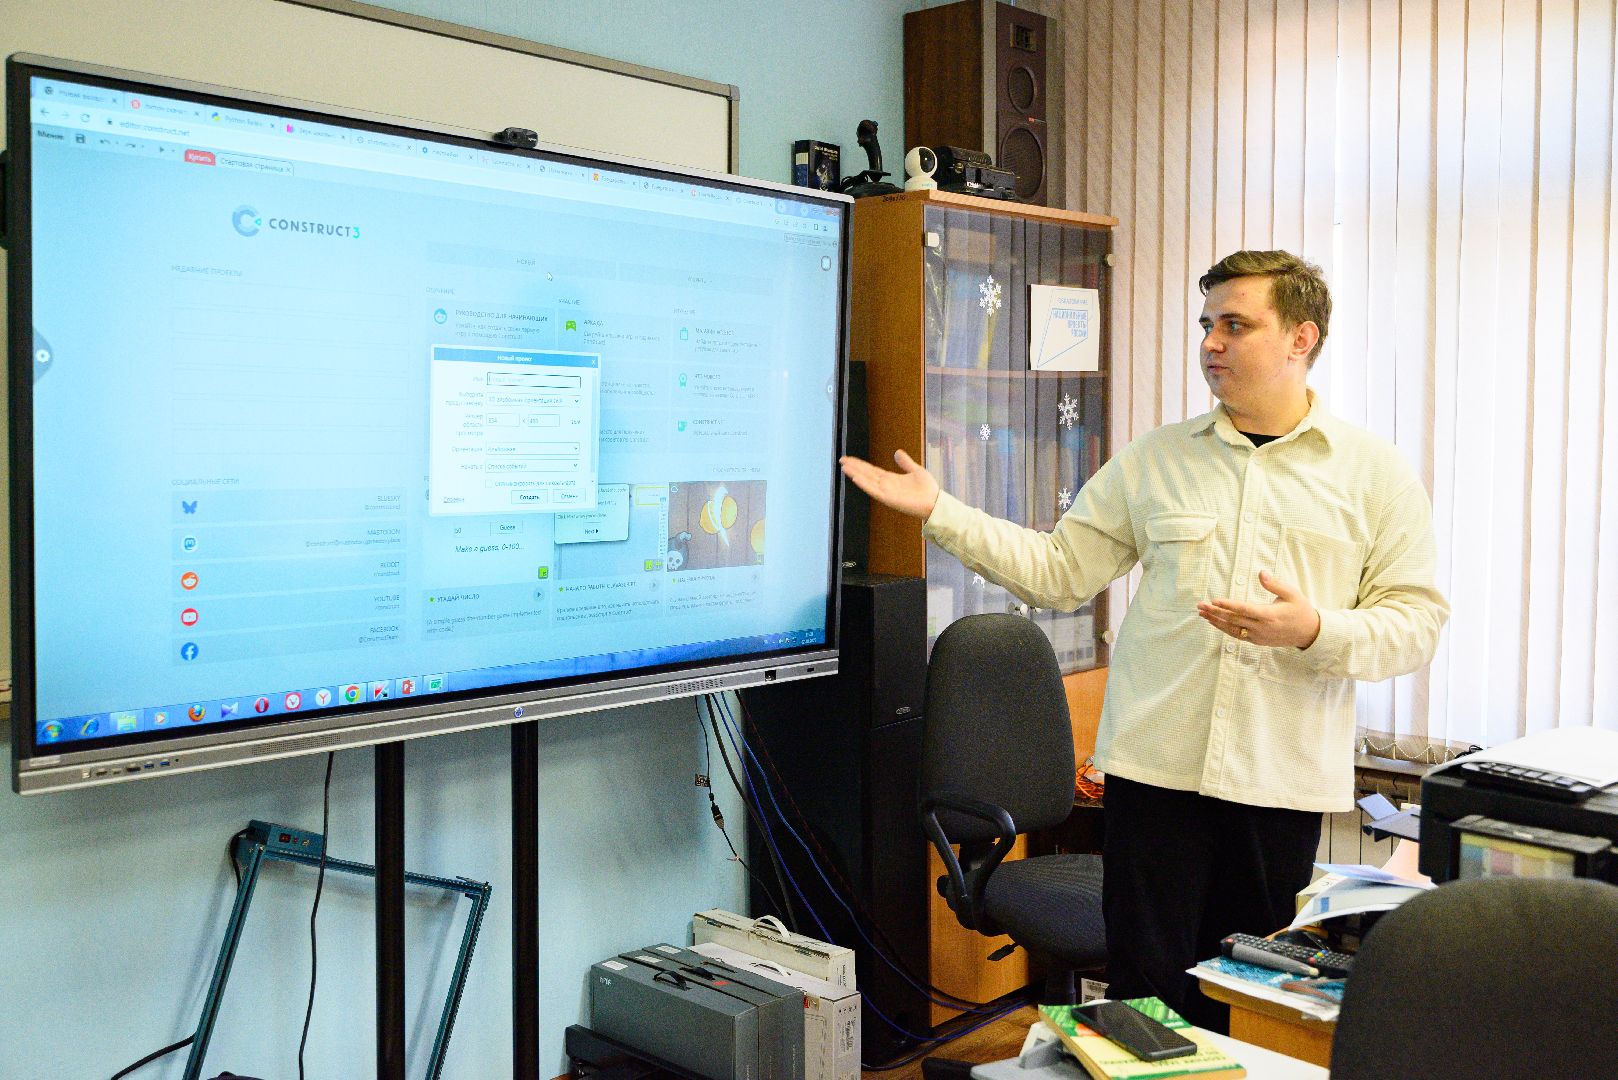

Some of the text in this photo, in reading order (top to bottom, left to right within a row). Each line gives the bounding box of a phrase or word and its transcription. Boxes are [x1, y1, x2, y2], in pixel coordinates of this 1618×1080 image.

[220, 157, 284, 173] Стартовая страница
[499, 524, 516, 532] Guess
[454, 545, 473, 553] Make
[373, 594, 400, 602] YOUTUBE
[437, 594, 460, 602] УГАДАЙ
[369, 625, 400, 633] FACEBOOK
